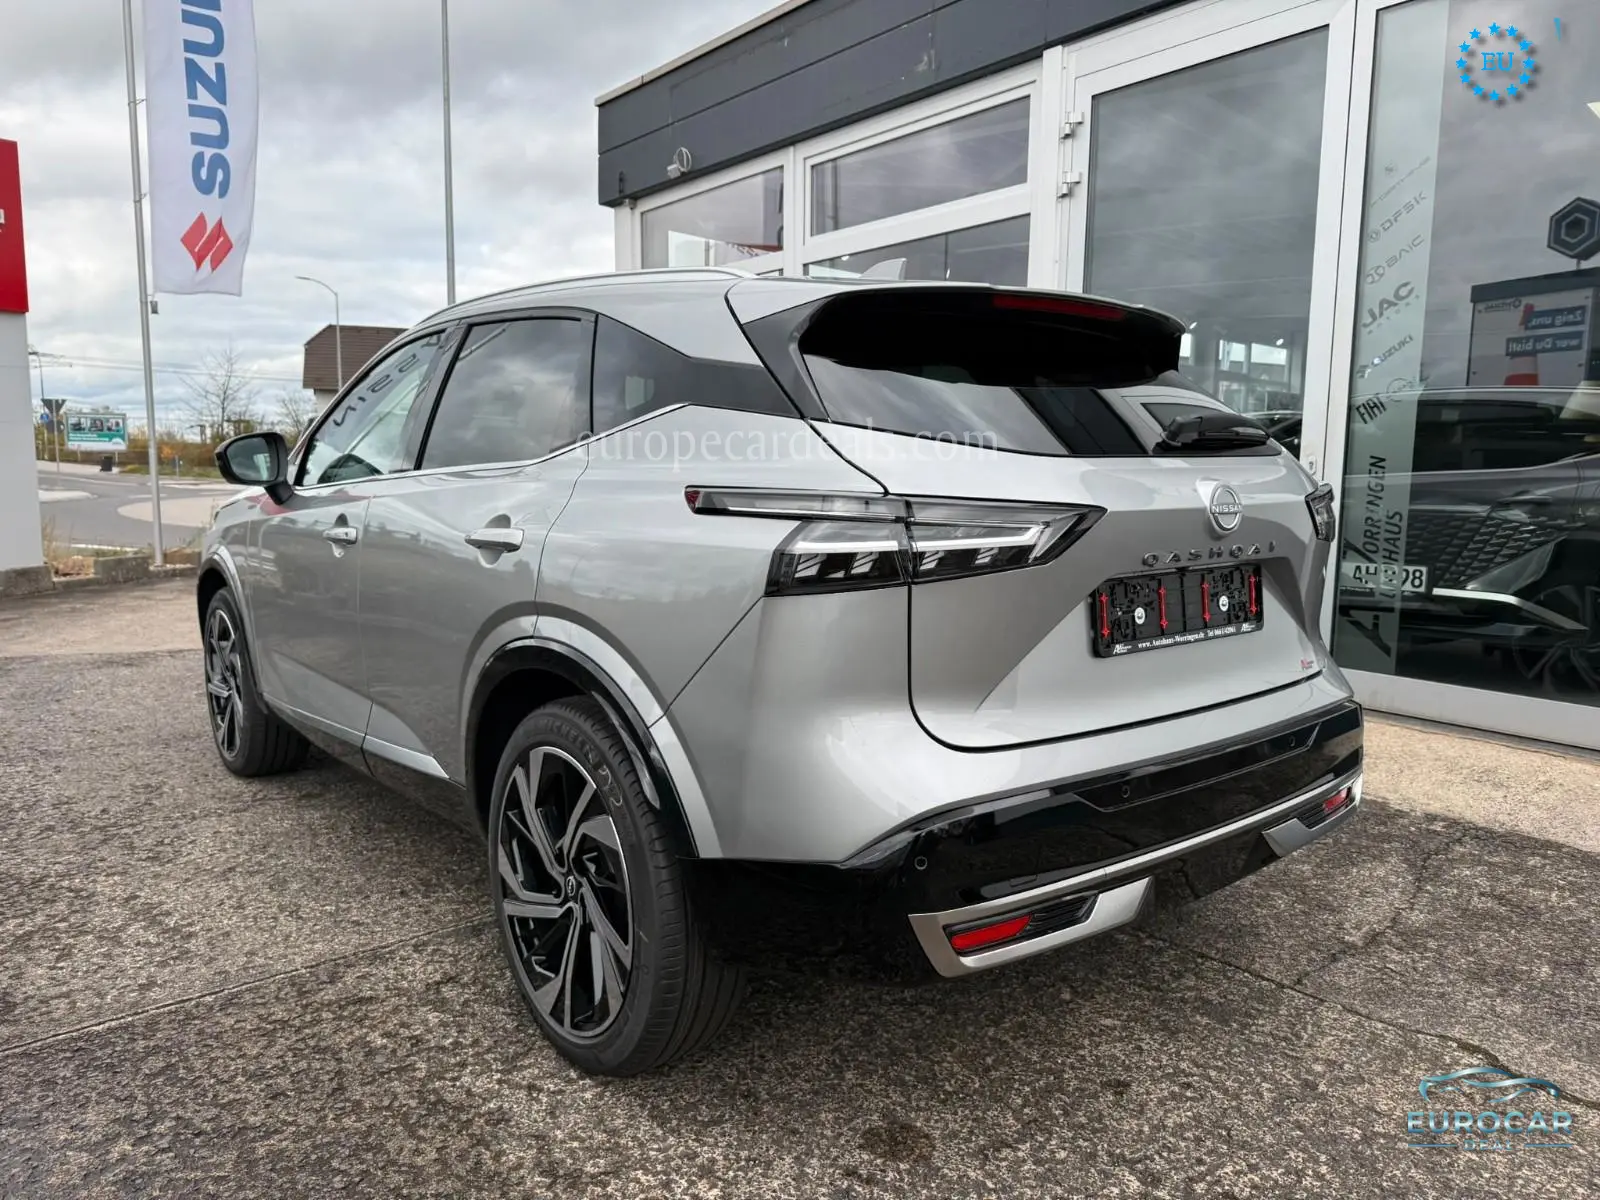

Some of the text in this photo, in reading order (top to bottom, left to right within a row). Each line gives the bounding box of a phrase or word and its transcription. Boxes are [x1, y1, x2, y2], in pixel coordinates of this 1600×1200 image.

[180, 0, 232, 199] SUZU
[1361, 281, 1415, 328] JAC
[1356, 396, 1387, 424] FIAT
[1212, 503, 1243, 514] NISSAN
[1142, 541, 1276, 567] QASHQAI
